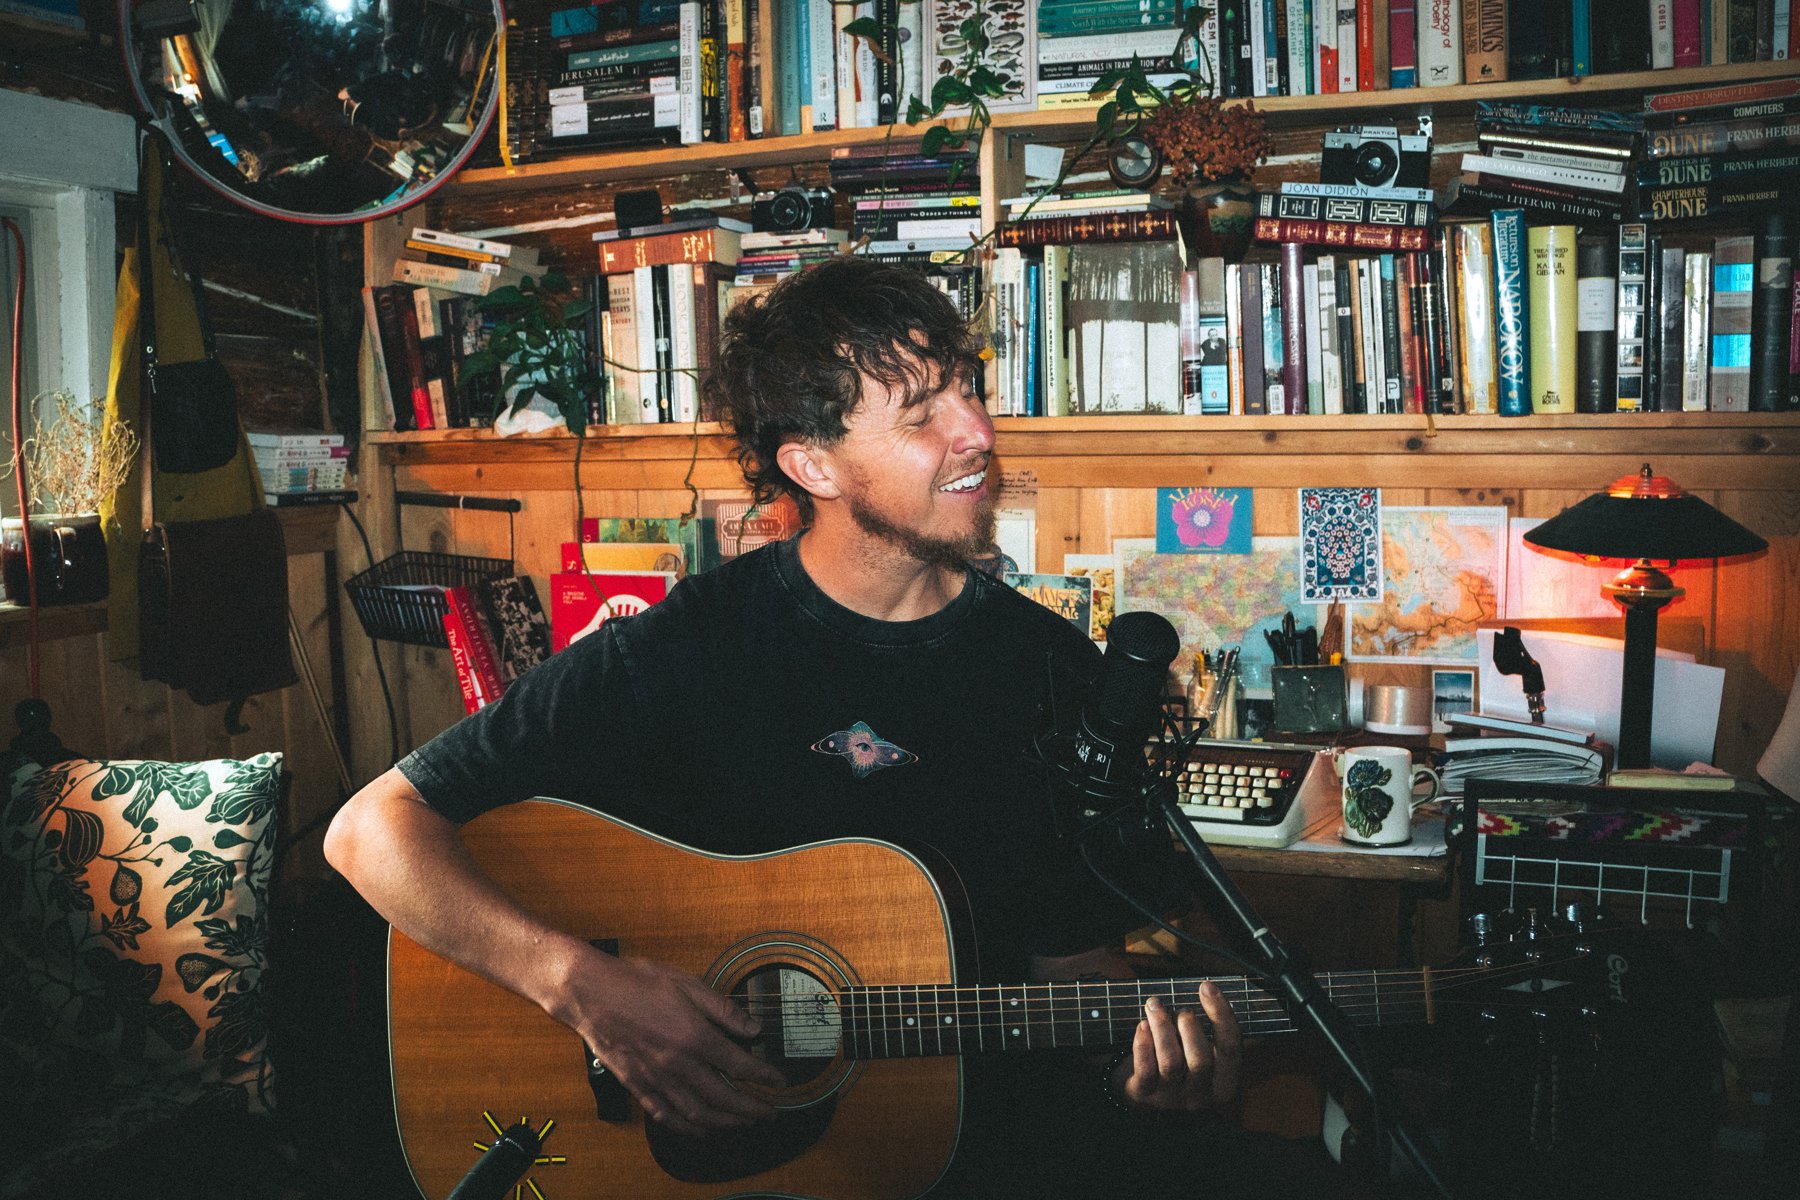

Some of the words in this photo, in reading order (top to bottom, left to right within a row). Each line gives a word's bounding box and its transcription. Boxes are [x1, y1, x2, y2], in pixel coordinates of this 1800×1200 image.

[1296, 8, 1305, 37] SECRET
[1431, 0, 1441, 30] Poetry
[1482, 0, 1504, 53] MMINGS
[1298, 38, 1306, 68] WORLD
[560, 65, 624, 83] JERUSALEM
[1077, 62, 1104, 72] ANIMALS
[1106, 61, 1113, 70] IN
[1055, 81, 1084, 90] CLIMATE
[1657, 93, 1699, 105] DESTINY
[1733, 103, 1784, 117] COMPUTERS
[1727, 129, 1764, 142] FRANK
[1653, 132, 1714, 158] DUNE
[1527, 151, 1539, 161] the
[1539, 154, 1593, 169] metamorphoses
[1723, 161, 1755, 172] FRANK
[1756, 156, 1800, 169] HERBERT
[1659, 164, 1712, 186] DUNE
[1286, 183, 1320, 194] JOAN
[1324, 185, 1369, 197] DIDION
[1651, 187, 1708, 201] CHAPTERHOUSE
[1722, 193, 1746, 204] FRANK
[1746, 190, 1779, 203] HERBERT
[1506, 194, 1556, 211] LITERARY
[1562, 203, 1602, 218] THEORY
[1652, 198, 1708, 221] DUNE
[1499, 267, 1524, 385] NABOKOV
[448, 628, 458, 645] The
[452, 645, 465, 667] Art
[460, 675, 473, 701] Tile
